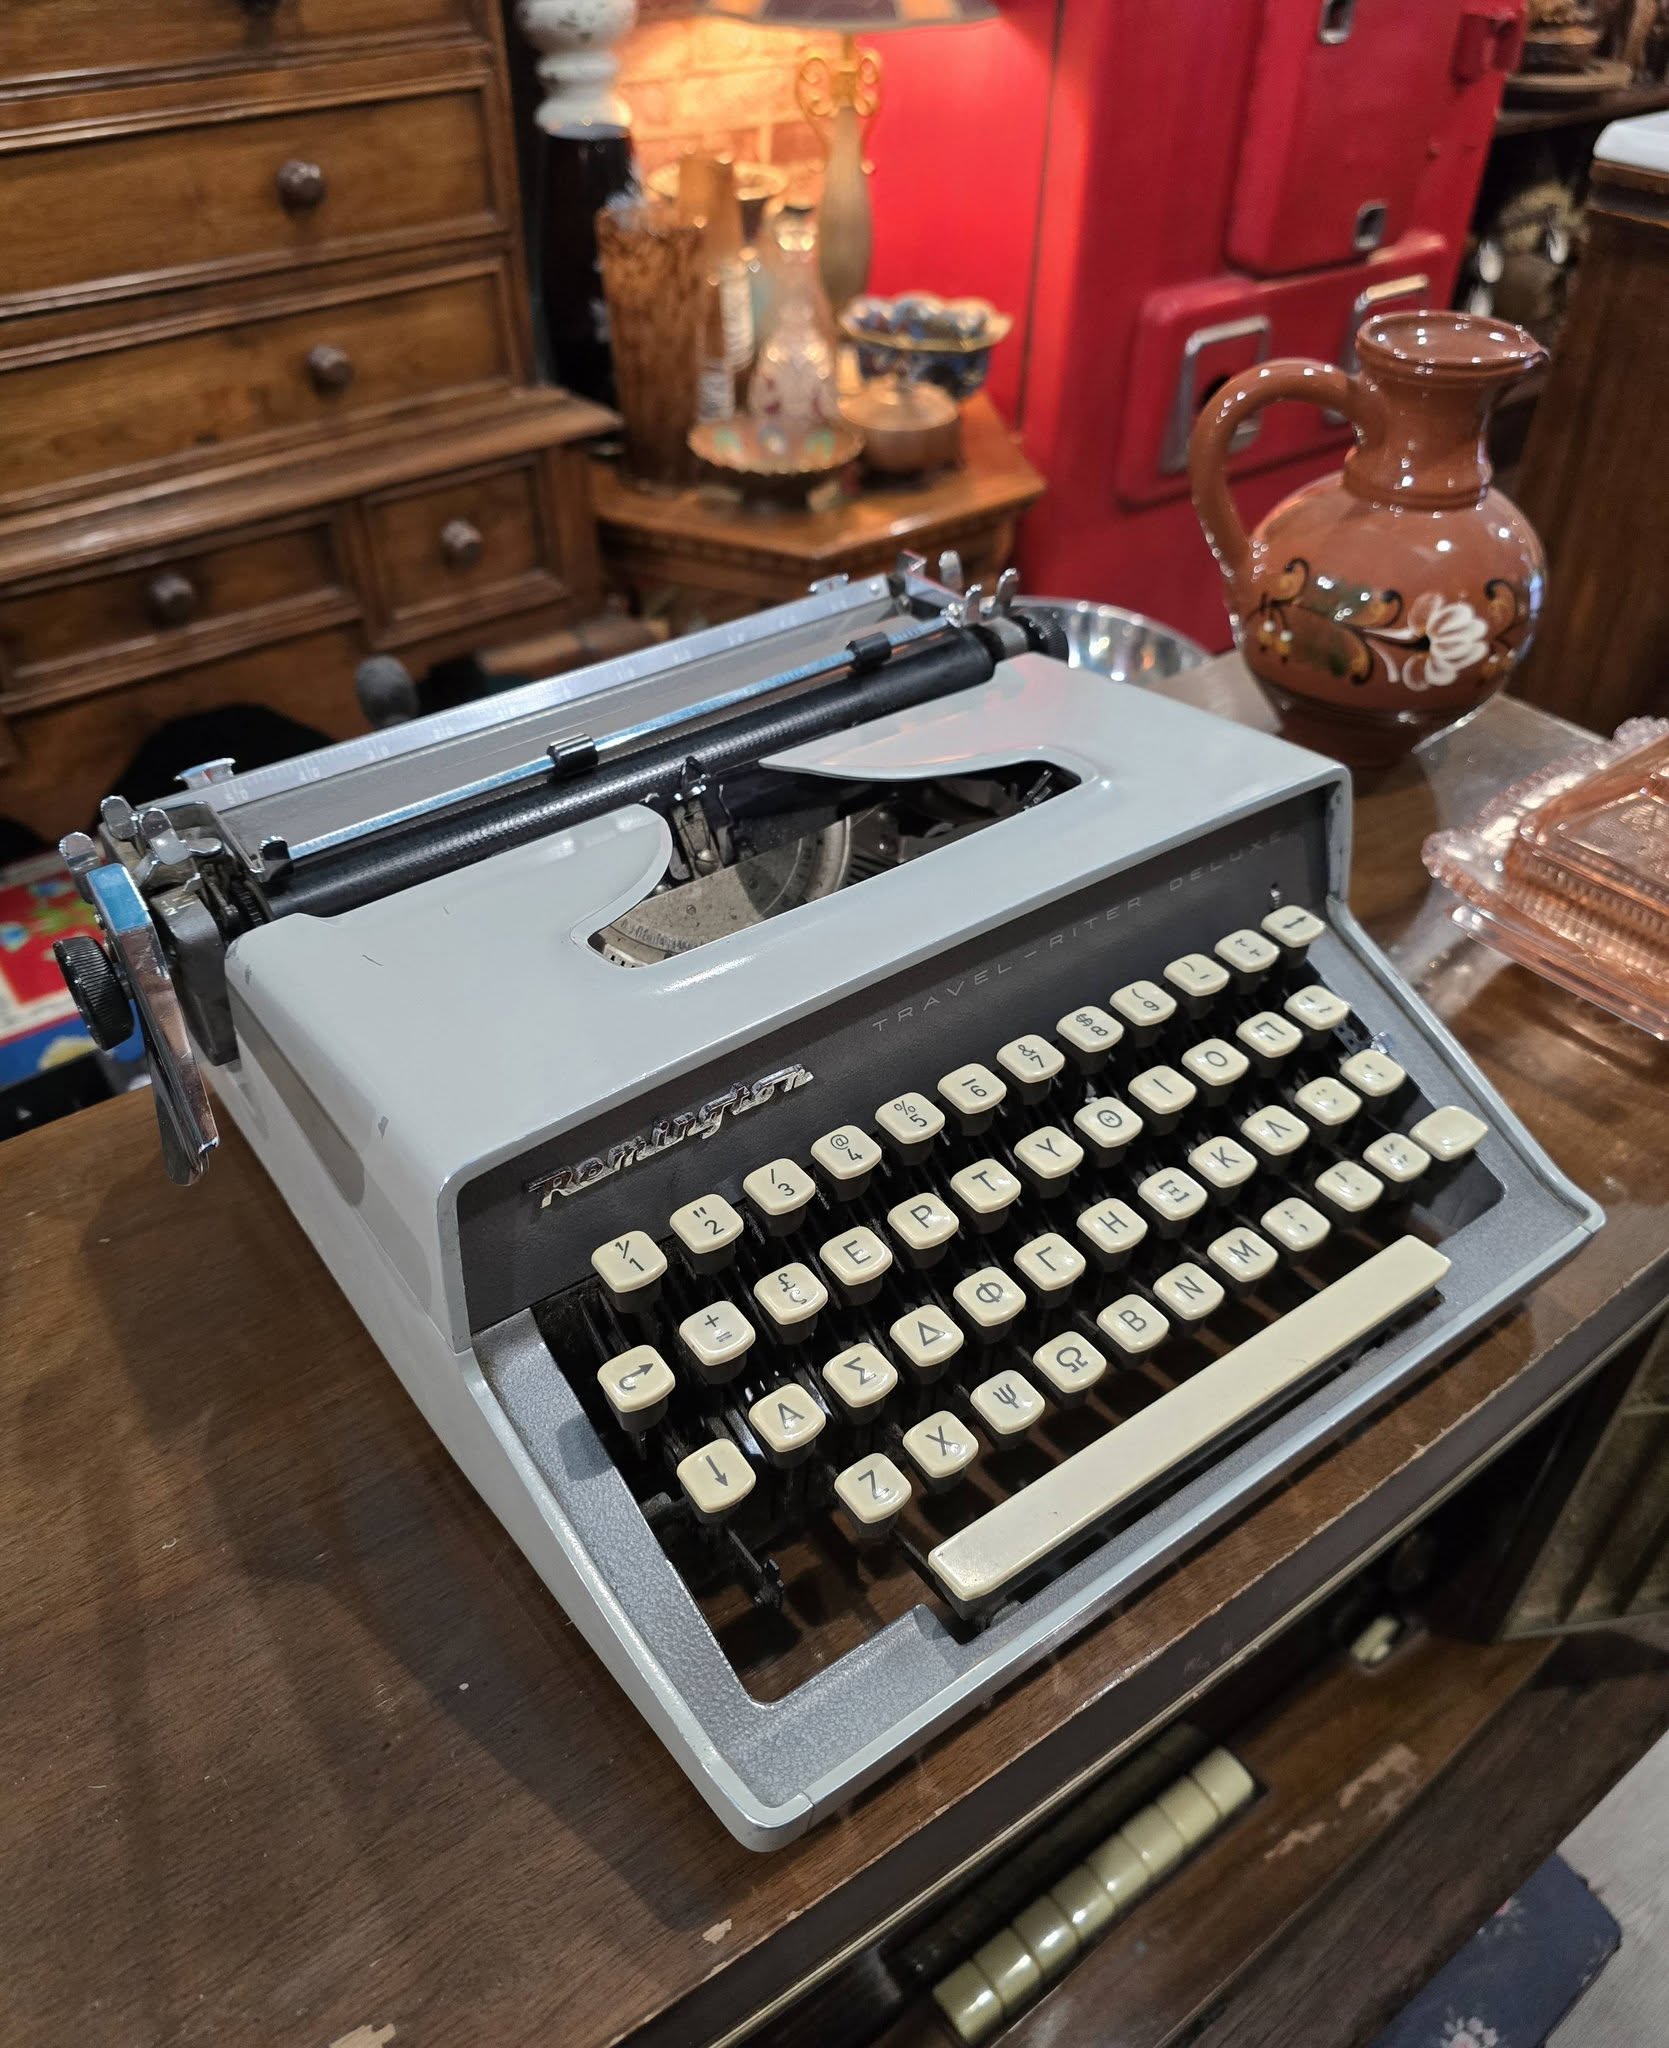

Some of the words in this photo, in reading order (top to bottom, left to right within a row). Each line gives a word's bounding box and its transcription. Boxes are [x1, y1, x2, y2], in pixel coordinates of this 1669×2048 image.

[1169, 831, 1281, 891] DELUXE
[1255, 1020, 1286, 1041] Π
[1097, 1110, 1122, 1128] Θ
[1265, 1120, 1291, 1137] Λ
[527, 1063, 814, 1208] Remington
[1158, 1179, 1190, 1202] Ξ
[1036, 1246, 1056, 1271] Γ
[976, 1282, 1003, 1303] Φ
[918, 1321, 945, 1346] Δ
[843, 1357, 876, 1385] Σ
[1056, 1346, 1089, 1373] Ω
[993, 1384, 1019, 1408] Ψ
